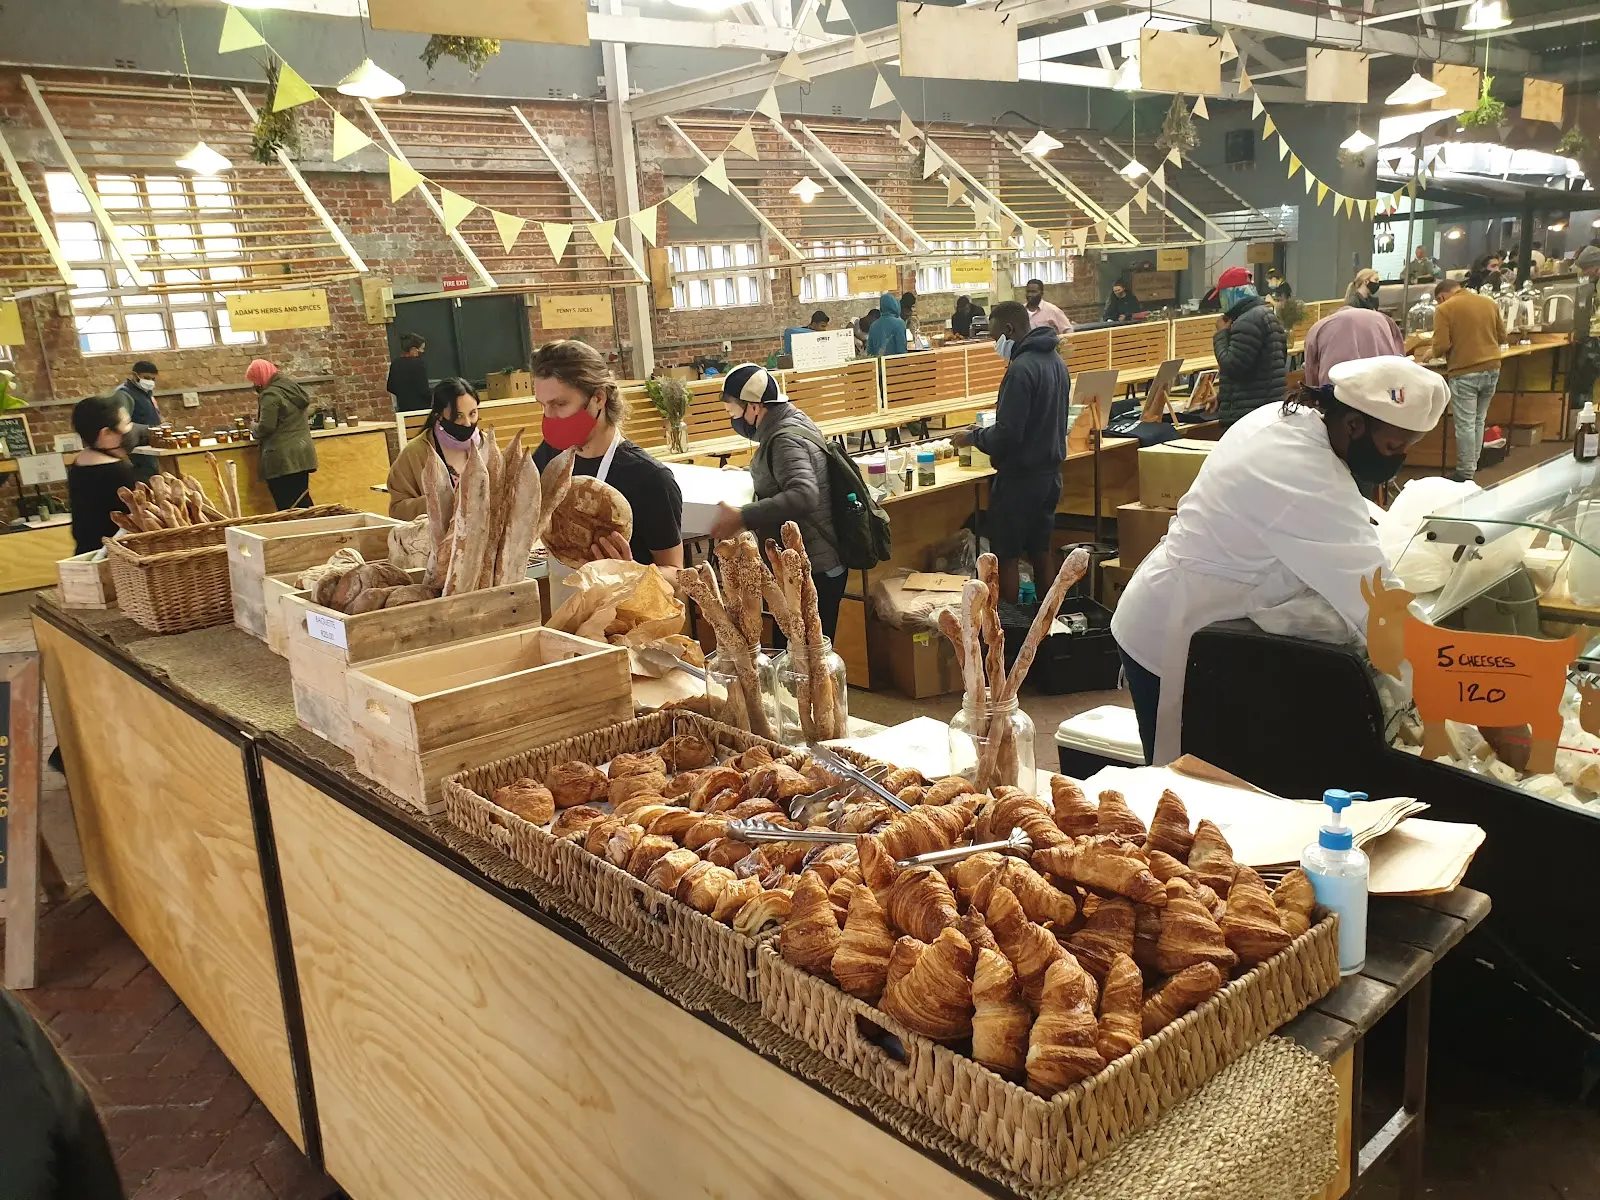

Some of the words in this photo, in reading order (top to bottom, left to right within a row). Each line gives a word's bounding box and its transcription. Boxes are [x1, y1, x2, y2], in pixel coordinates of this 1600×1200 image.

[234, 308, 259, 316] ADAM'S
[1437, 644, 1455, 668] 5
[1458, 653, 1516, 668] CHEESES
[1457, 681, 1506, 703] 120
